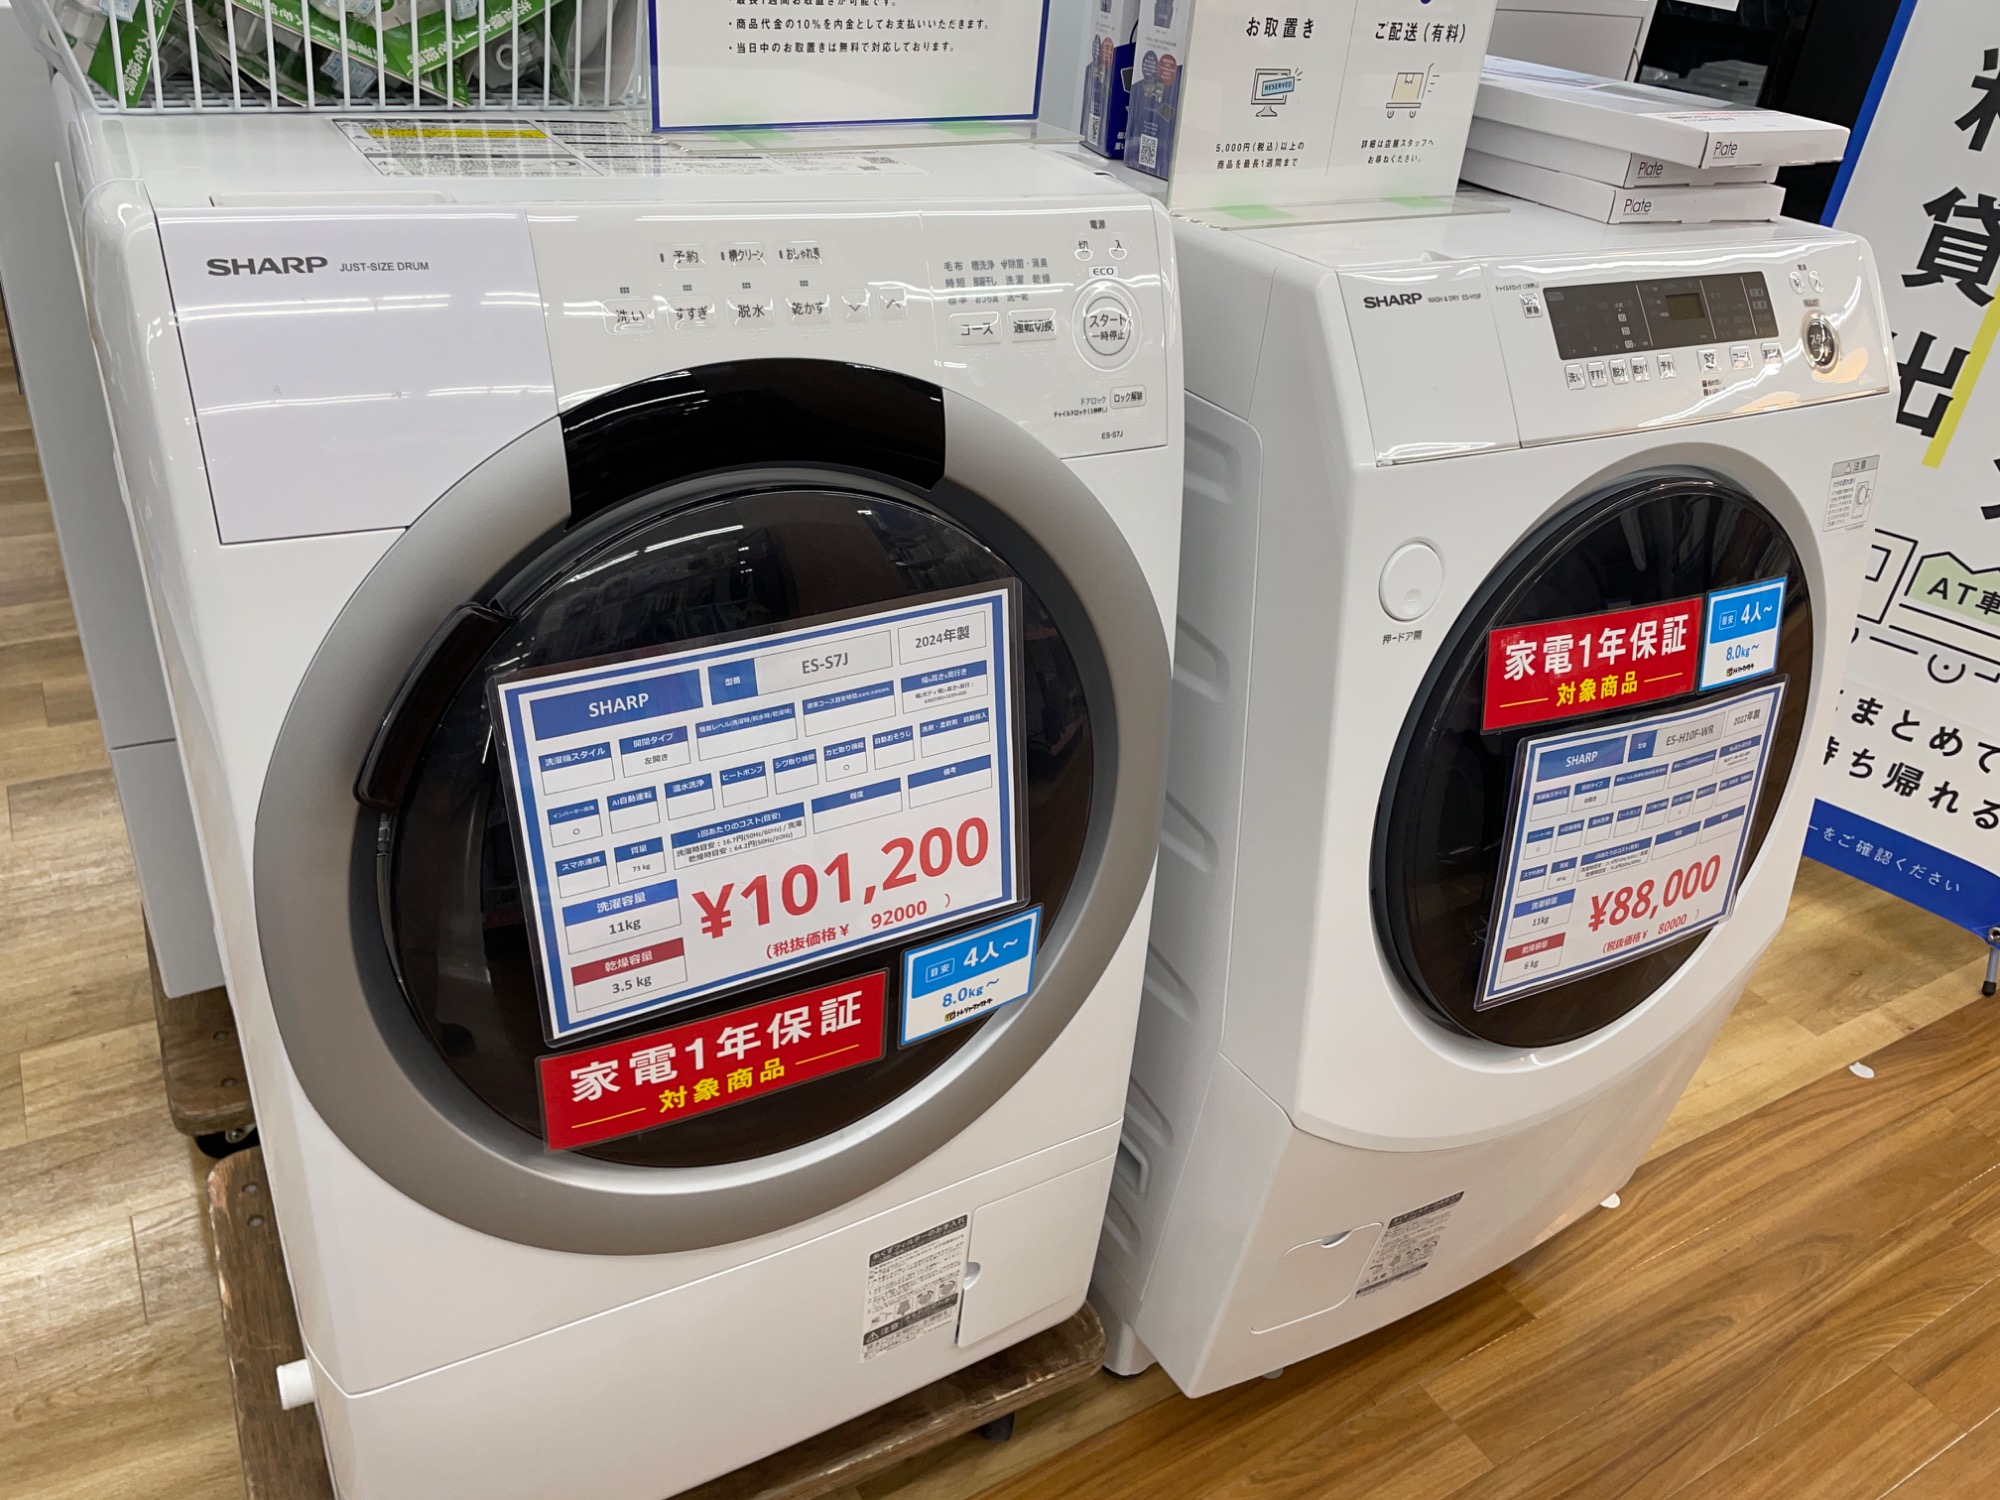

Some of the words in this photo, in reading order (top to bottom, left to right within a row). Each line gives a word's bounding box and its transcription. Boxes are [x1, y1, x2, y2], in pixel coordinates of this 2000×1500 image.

[1245, 16, 1315, 39] お取置き
[1375, 22, 1466, 43] ご配送(有料)
[1264, 81, 1292, 91] RESERVED
[1713, 141, 1738, 157] Plate
[1217, 158, 1299, 169] 商品を最長1週間まで
[1638, 161, 1663, 177] Plate
[1623, 198, 1652, 214] Plate
[1089, 219, 1106, 230] 電源
[673, 250, 698, 263] 予約
[206, 256, 328, 276] SHARP
[339, 262, 394, 272] JUST-SIZE
[397, 261, 429, 271] DRUM
[1092, 267, 1114, 276] ECO
[791, 301, 824, 315] 乾かす
[1363, 293, 1422, 309] SHARP
[616, 309, 645, 323] 洗い
[675, 305, 708, 321] すすぎ
[738, 304, 765, 318] 脱水
[960, 321, 994, 336] コース
[1089, 315, 1128, 328] スタート
[1091, 331, 1125, 341] 一時停止
[1081, 396, 1106, 406] ドアロック
[1113, 391, 1143, 403] ロック解除
[1101, 431, 1123, 440] ES-S7J
[915, 625, 970, 648] 2024年製
[1504, 614, 1689, 681] 家電1年保証
[802, 652, 849, 674] ES-S7J
[1556, 671, 1638, 707] 対象商品
[589, 693, 649, 717] SHARP
[1733, 709, 1761, 726] 2022年製
[874, 730, 912, 745] 自動おそうじ
[1666, 725, 1714, 746] ES-H10F-WR
[1836, 690, 2000, 774] まとめて
[545, 747, 606, 767] 洗濯機スタイル
[644, 753, 668, 766] 左開き
[1565, 751, 1598, 767] SHARP
[722, 766, 763, 781] ヒートポンプ
[612, 790, 653, 807] AI自動運転
[632, 865, 641, 873] 73
[642, 863, 651, 872] kg
[691, 817, 989, 939] ¥101,200
[1588, 855, 1720, 932] ¥88,000
[596, 891, 647, 914] 洗濯容量
[871, 900, 927, 930] 92000
[1532, 915, 1549, 927] 11kg
[608, 918, 641, 936] 11kg
[1658, 914, 1687, 934] 80000
[605, 950, 653, 973] 乾燥容量
[1524, 961, 1529, 969] 6
[1530, 959, 1539, 969] kg
[929, 961, 951, 979] 目安
[612, 980, 633, 994] 3.5
[636, 975, 652, 988] kg
[570, 990, 863, 1103] 家電1年保証
[659, 1058, 785, 1113] 対象商品
